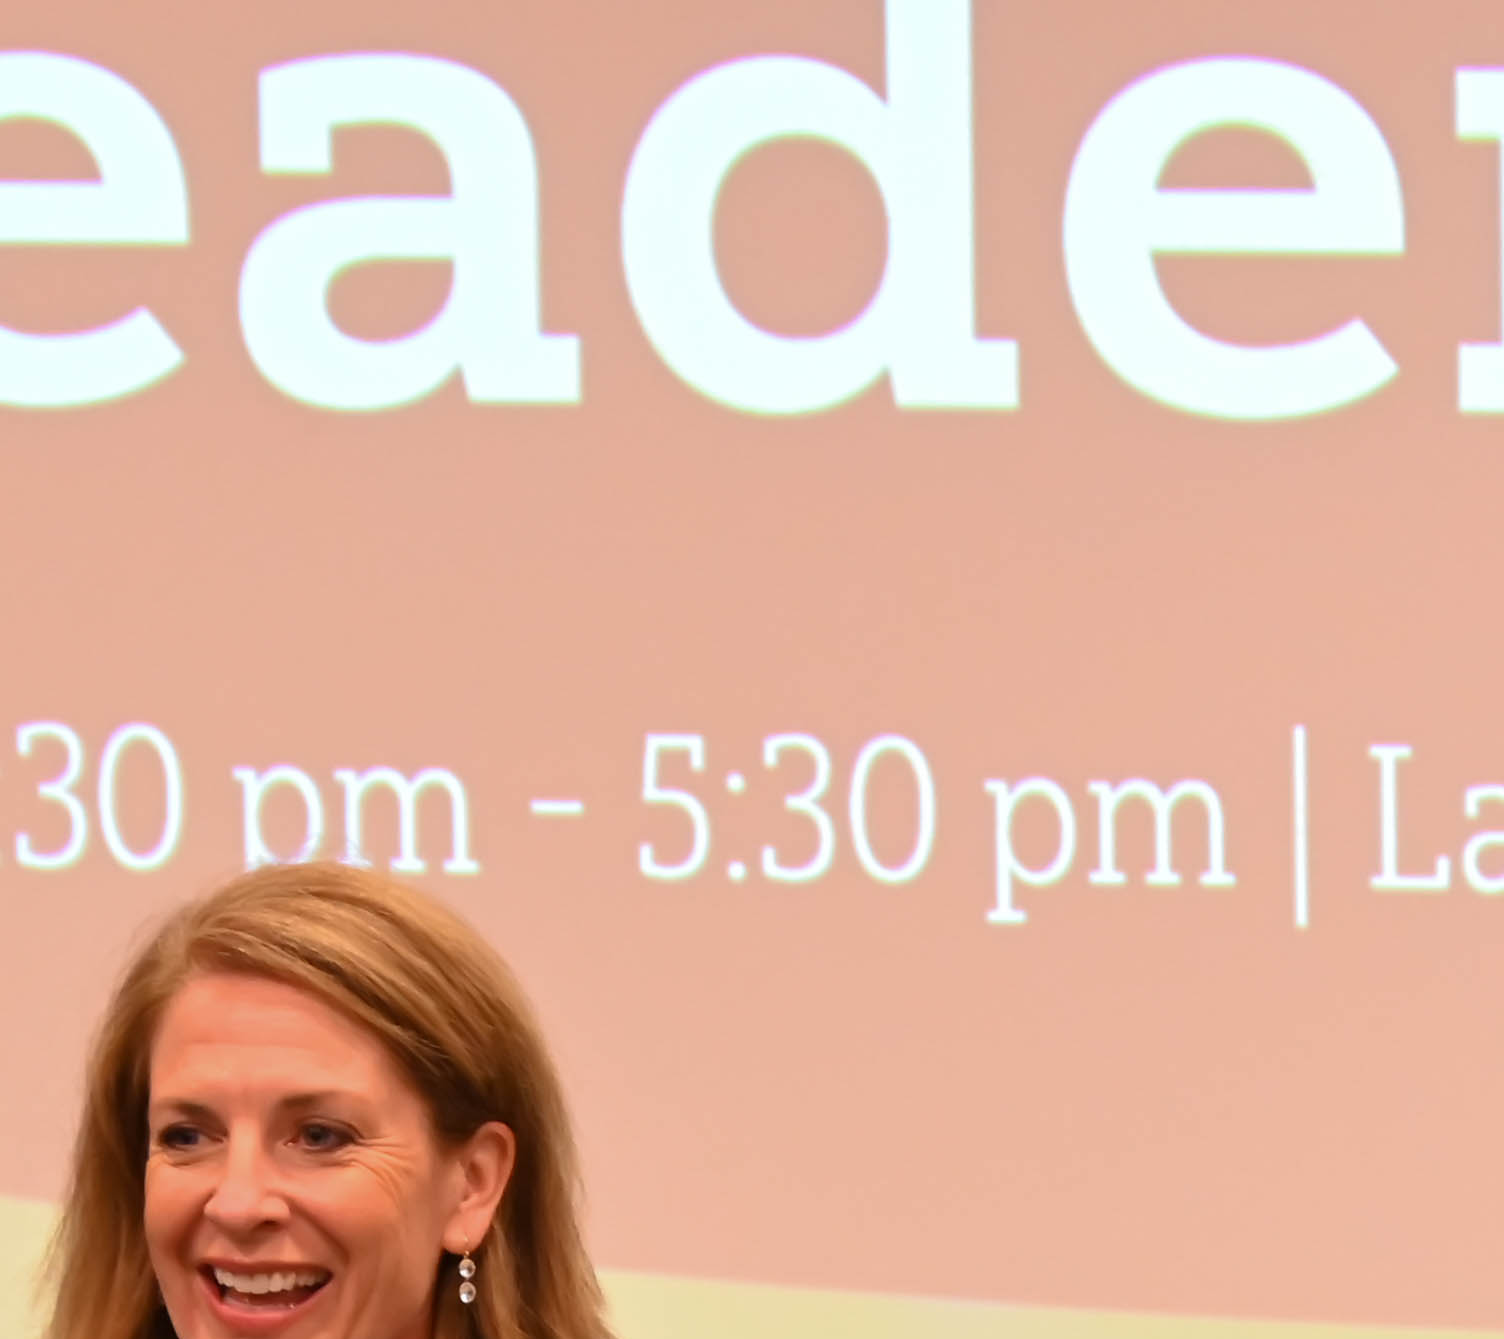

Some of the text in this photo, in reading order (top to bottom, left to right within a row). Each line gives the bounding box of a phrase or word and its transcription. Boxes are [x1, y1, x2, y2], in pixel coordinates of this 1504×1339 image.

[232, 761, 482, 874] pm
[638, 730, 937, 884] 5:30
[983, 773, 1238, 926] pm
